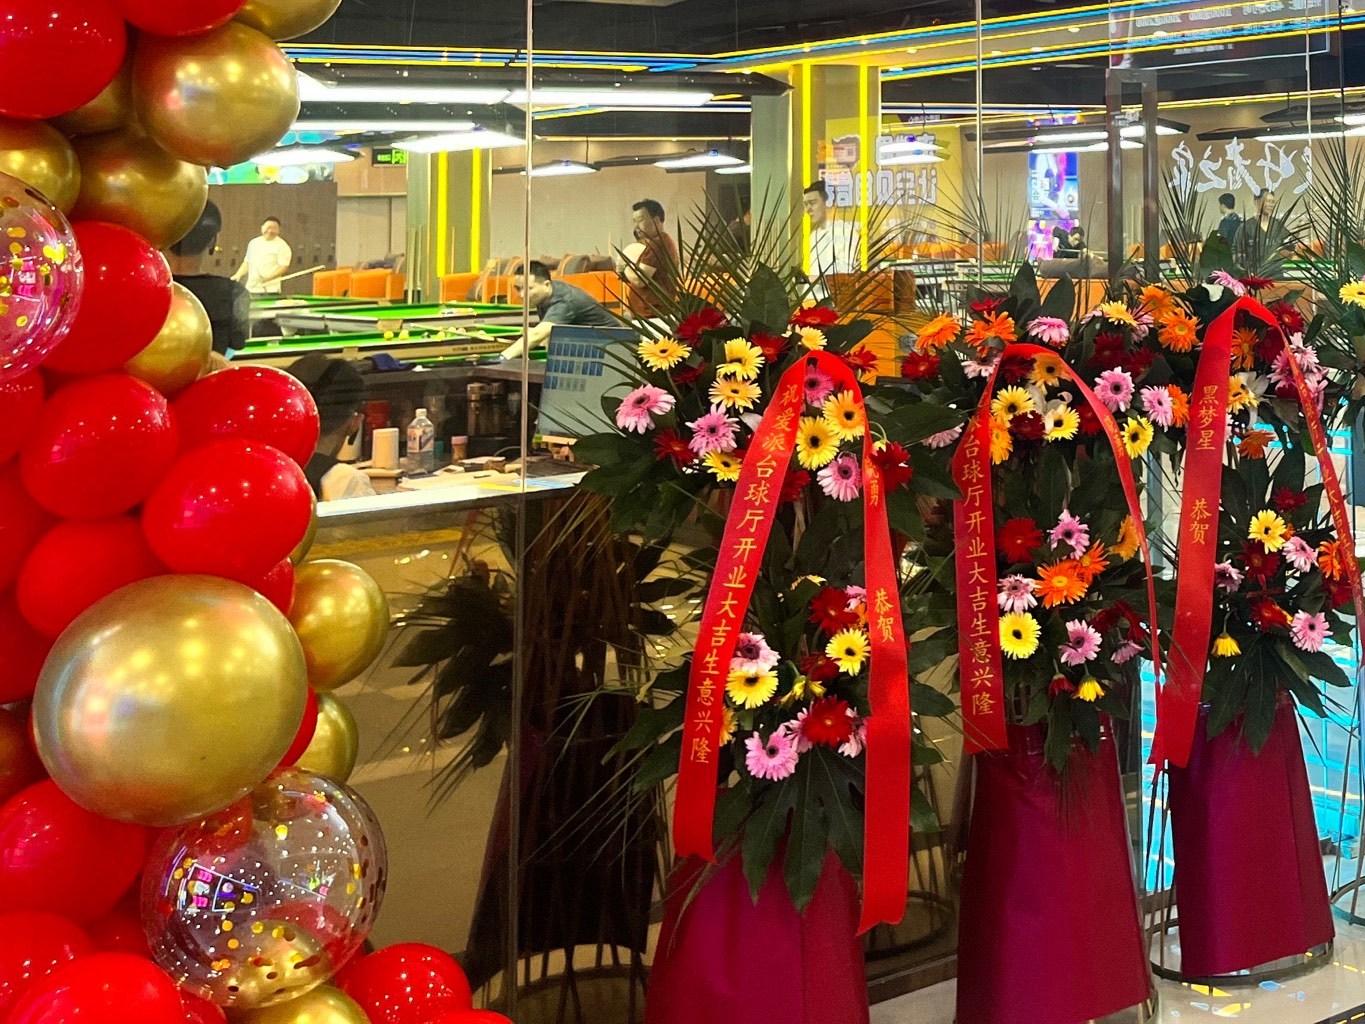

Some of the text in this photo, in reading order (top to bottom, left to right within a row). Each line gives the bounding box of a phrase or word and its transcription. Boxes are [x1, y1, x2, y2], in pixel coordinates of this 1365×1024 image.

[1196, 385, 1219, 451] 黑梦星
[1189, 497, 1212, 545] 恭贺
[690, 384, 800, 764] 祝爱派台球厅开业大吉生意兴隆
[874, 589, 895, 643] 恭贺
